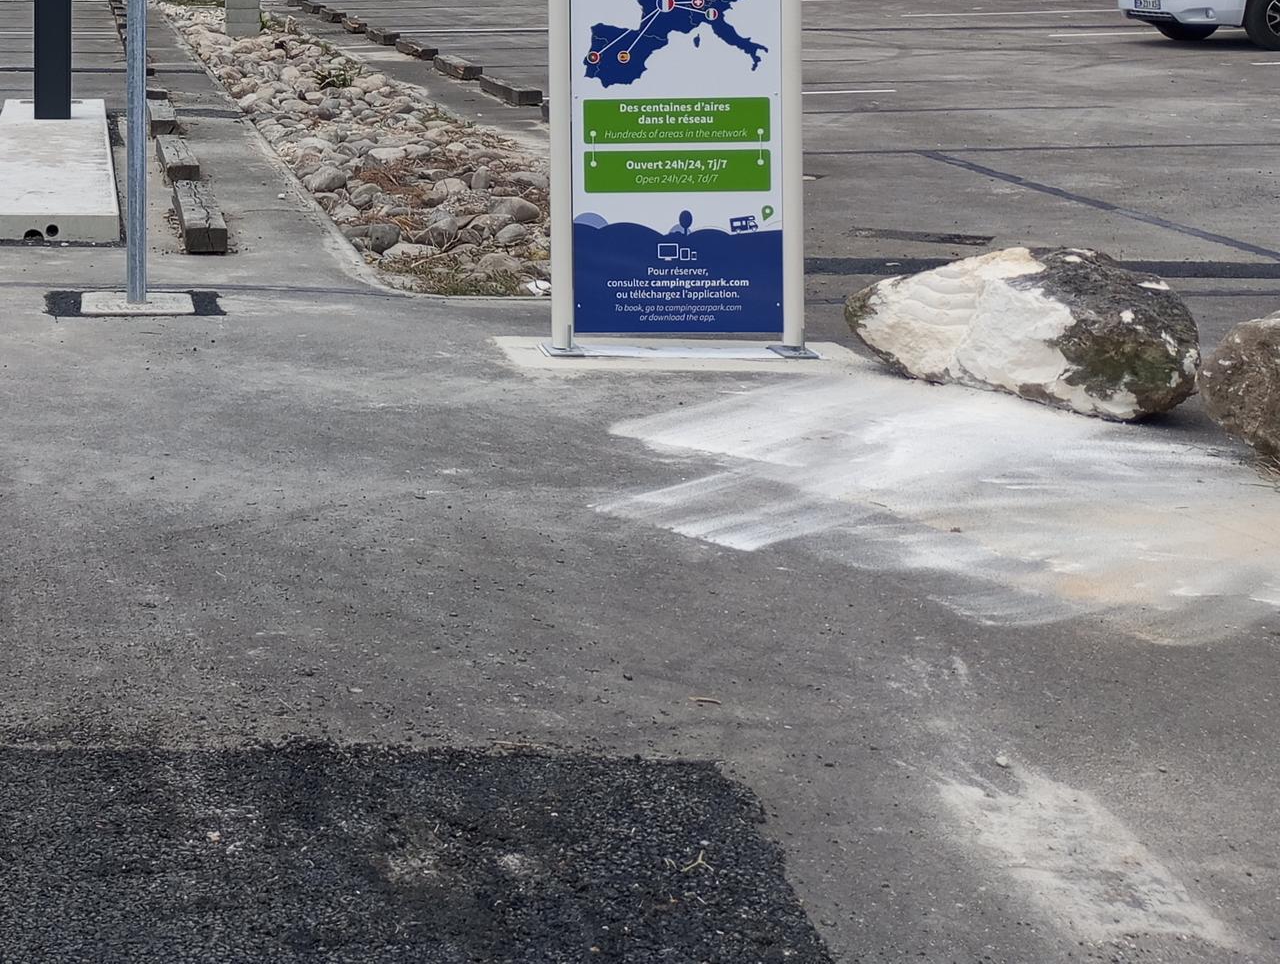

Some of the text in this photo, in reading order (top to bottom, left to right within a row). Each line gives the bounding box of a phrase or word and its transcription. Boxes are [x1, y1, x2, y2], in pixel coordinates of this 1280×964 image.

[620, 102, 730, 113] Des centaines d'aires
[638, 114, 714, 124] dans le réseau
[604, 130, 647, 139] Hundreds
[649, 130, 660, 139] of
[685, 129, 694, 137] in
[695, 129, 710, 137] the
[712, 128, 747, 137] network
[626, 159, 727, 171] Ouvert 24h/24, 7j/7
[636, 174, 719, 185] Open 24h/24, 7d/7
[648, 267, 708, 277] Pour réserver,
[607, 278, 749, 289] consultez campingcarpark.com
[630, 290, 680, 300] téléchargez
[682, 289, 740, 300] l'application.
[624, 304, 644, 312] book,
[645, 305, 655, 314] go
[665, 304, 742, 313] campingcarpark.com
[699, 314, 715, 323] app.
